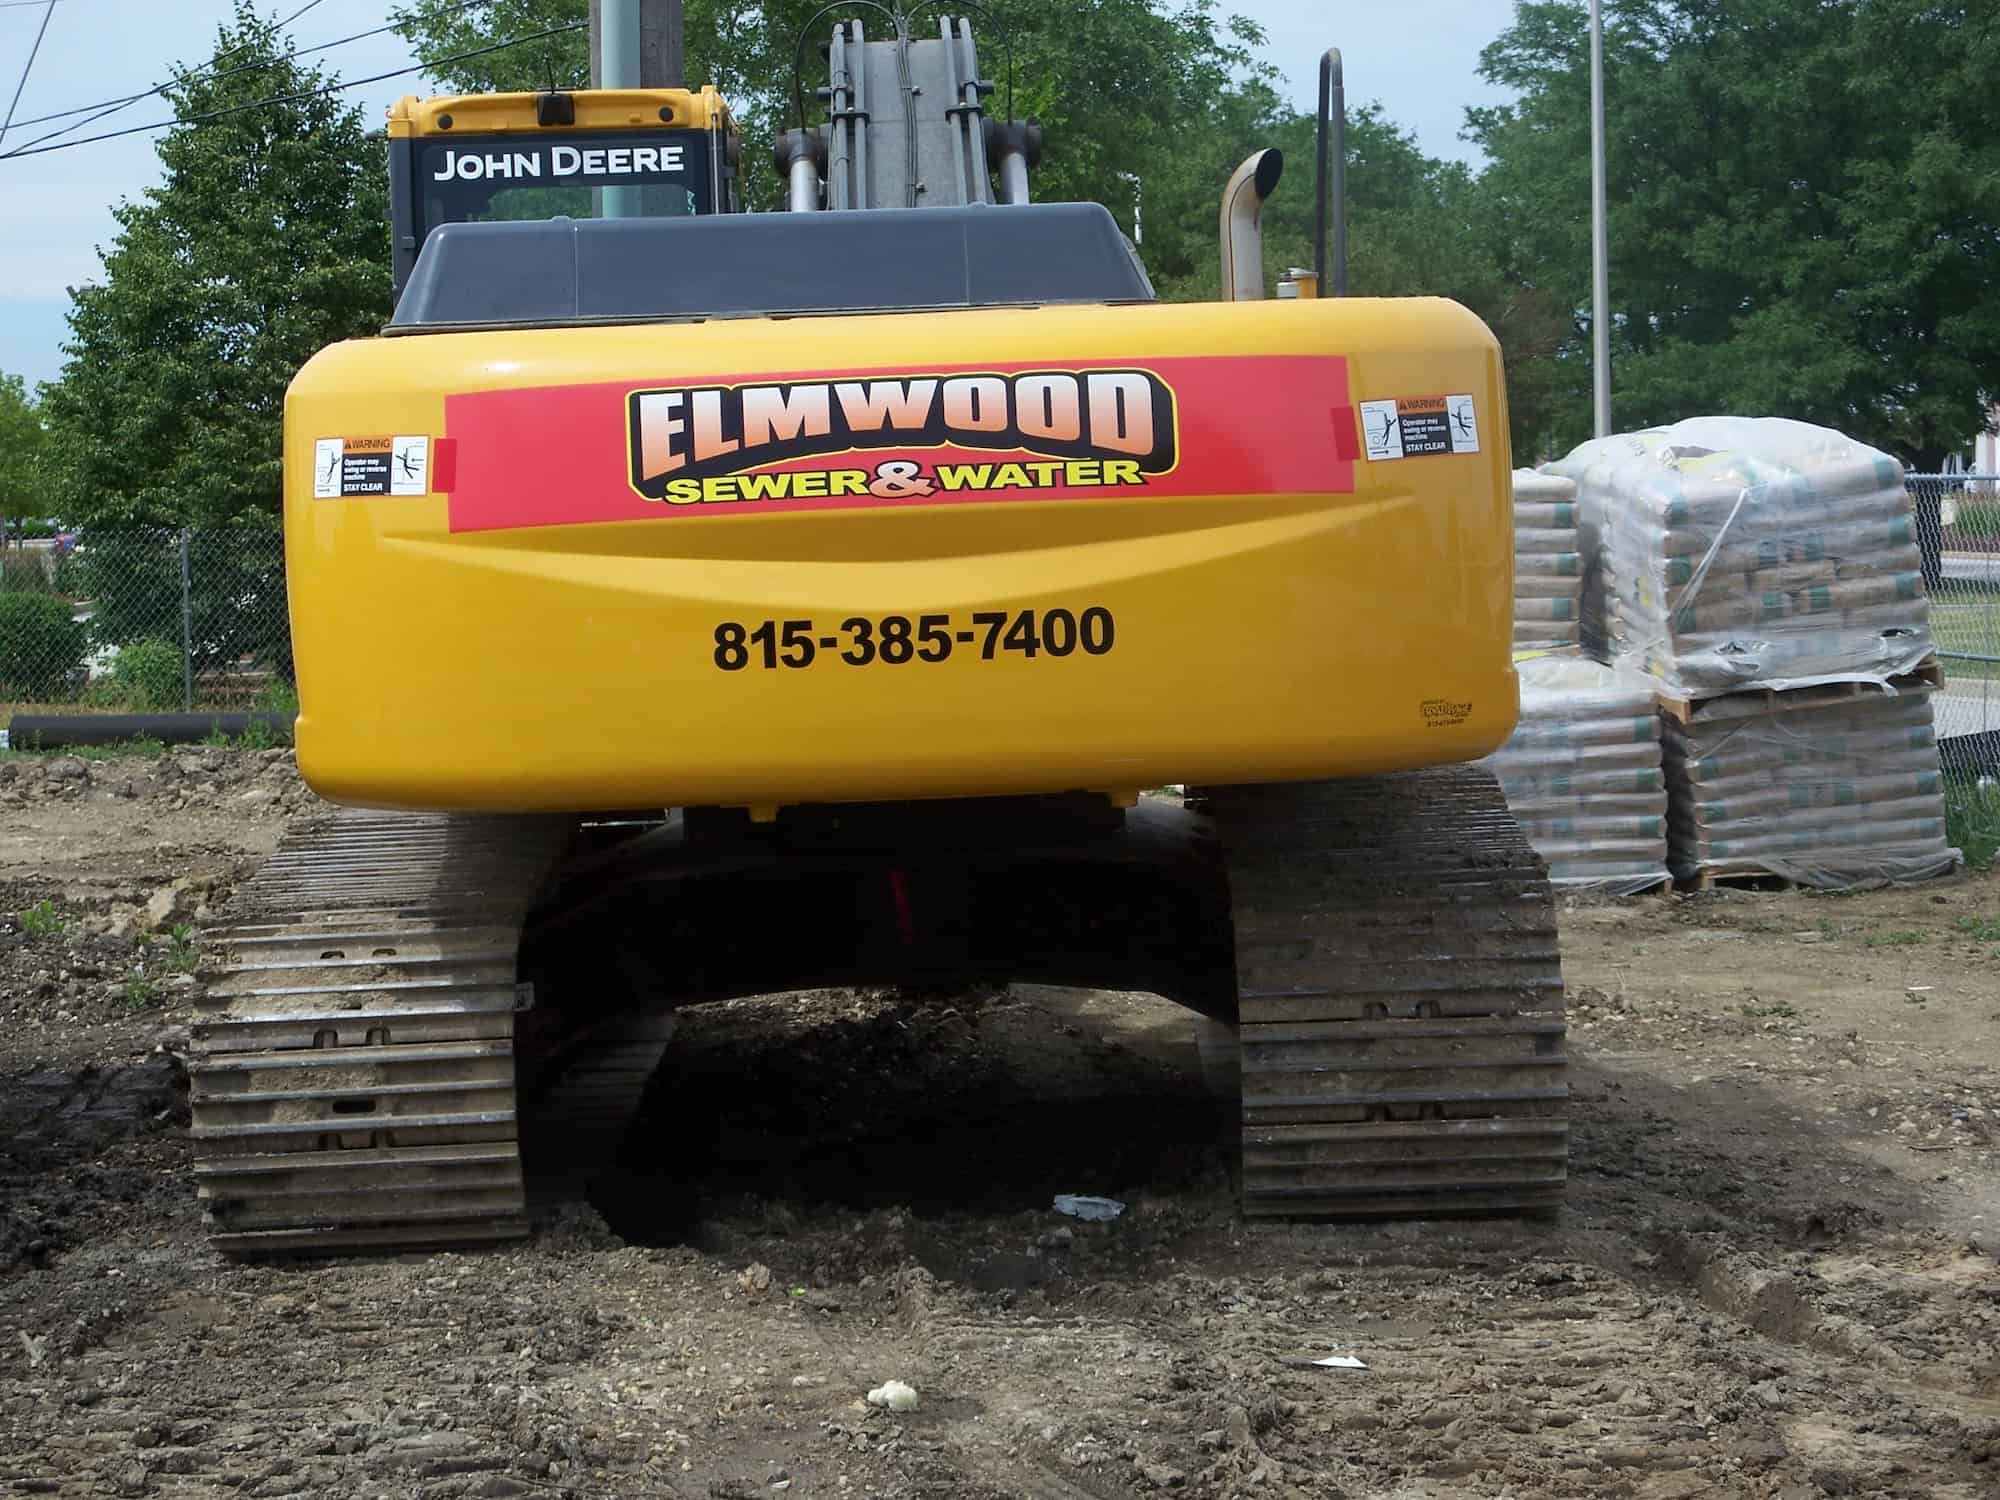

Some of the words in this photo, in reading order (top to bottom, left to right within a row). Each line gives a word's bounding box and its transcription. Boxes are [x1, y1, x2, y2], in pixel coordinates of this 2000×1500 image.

[434, 150, 541, 181] JOHN
[551, 146, 684, 176] DEERE
[1407, 399, 1446, 409] WARNING
[636, 371, 1157, 482] ELMWOOD
[352, 438, 391, 449] WARNING
[1406, 443, 1423, 452] STAY
[1424, 441, 1446, 450] CLEAR
[343, 483, 360, 492] STAY
[360, 482, 383, 491] CLEAR
[663, 470, 870, 505] SEWER
[870, 460, 936, 498] &
[937, 459, 1144, 491] WATER
[712, 606, 1116, 672] 815-385-7400
